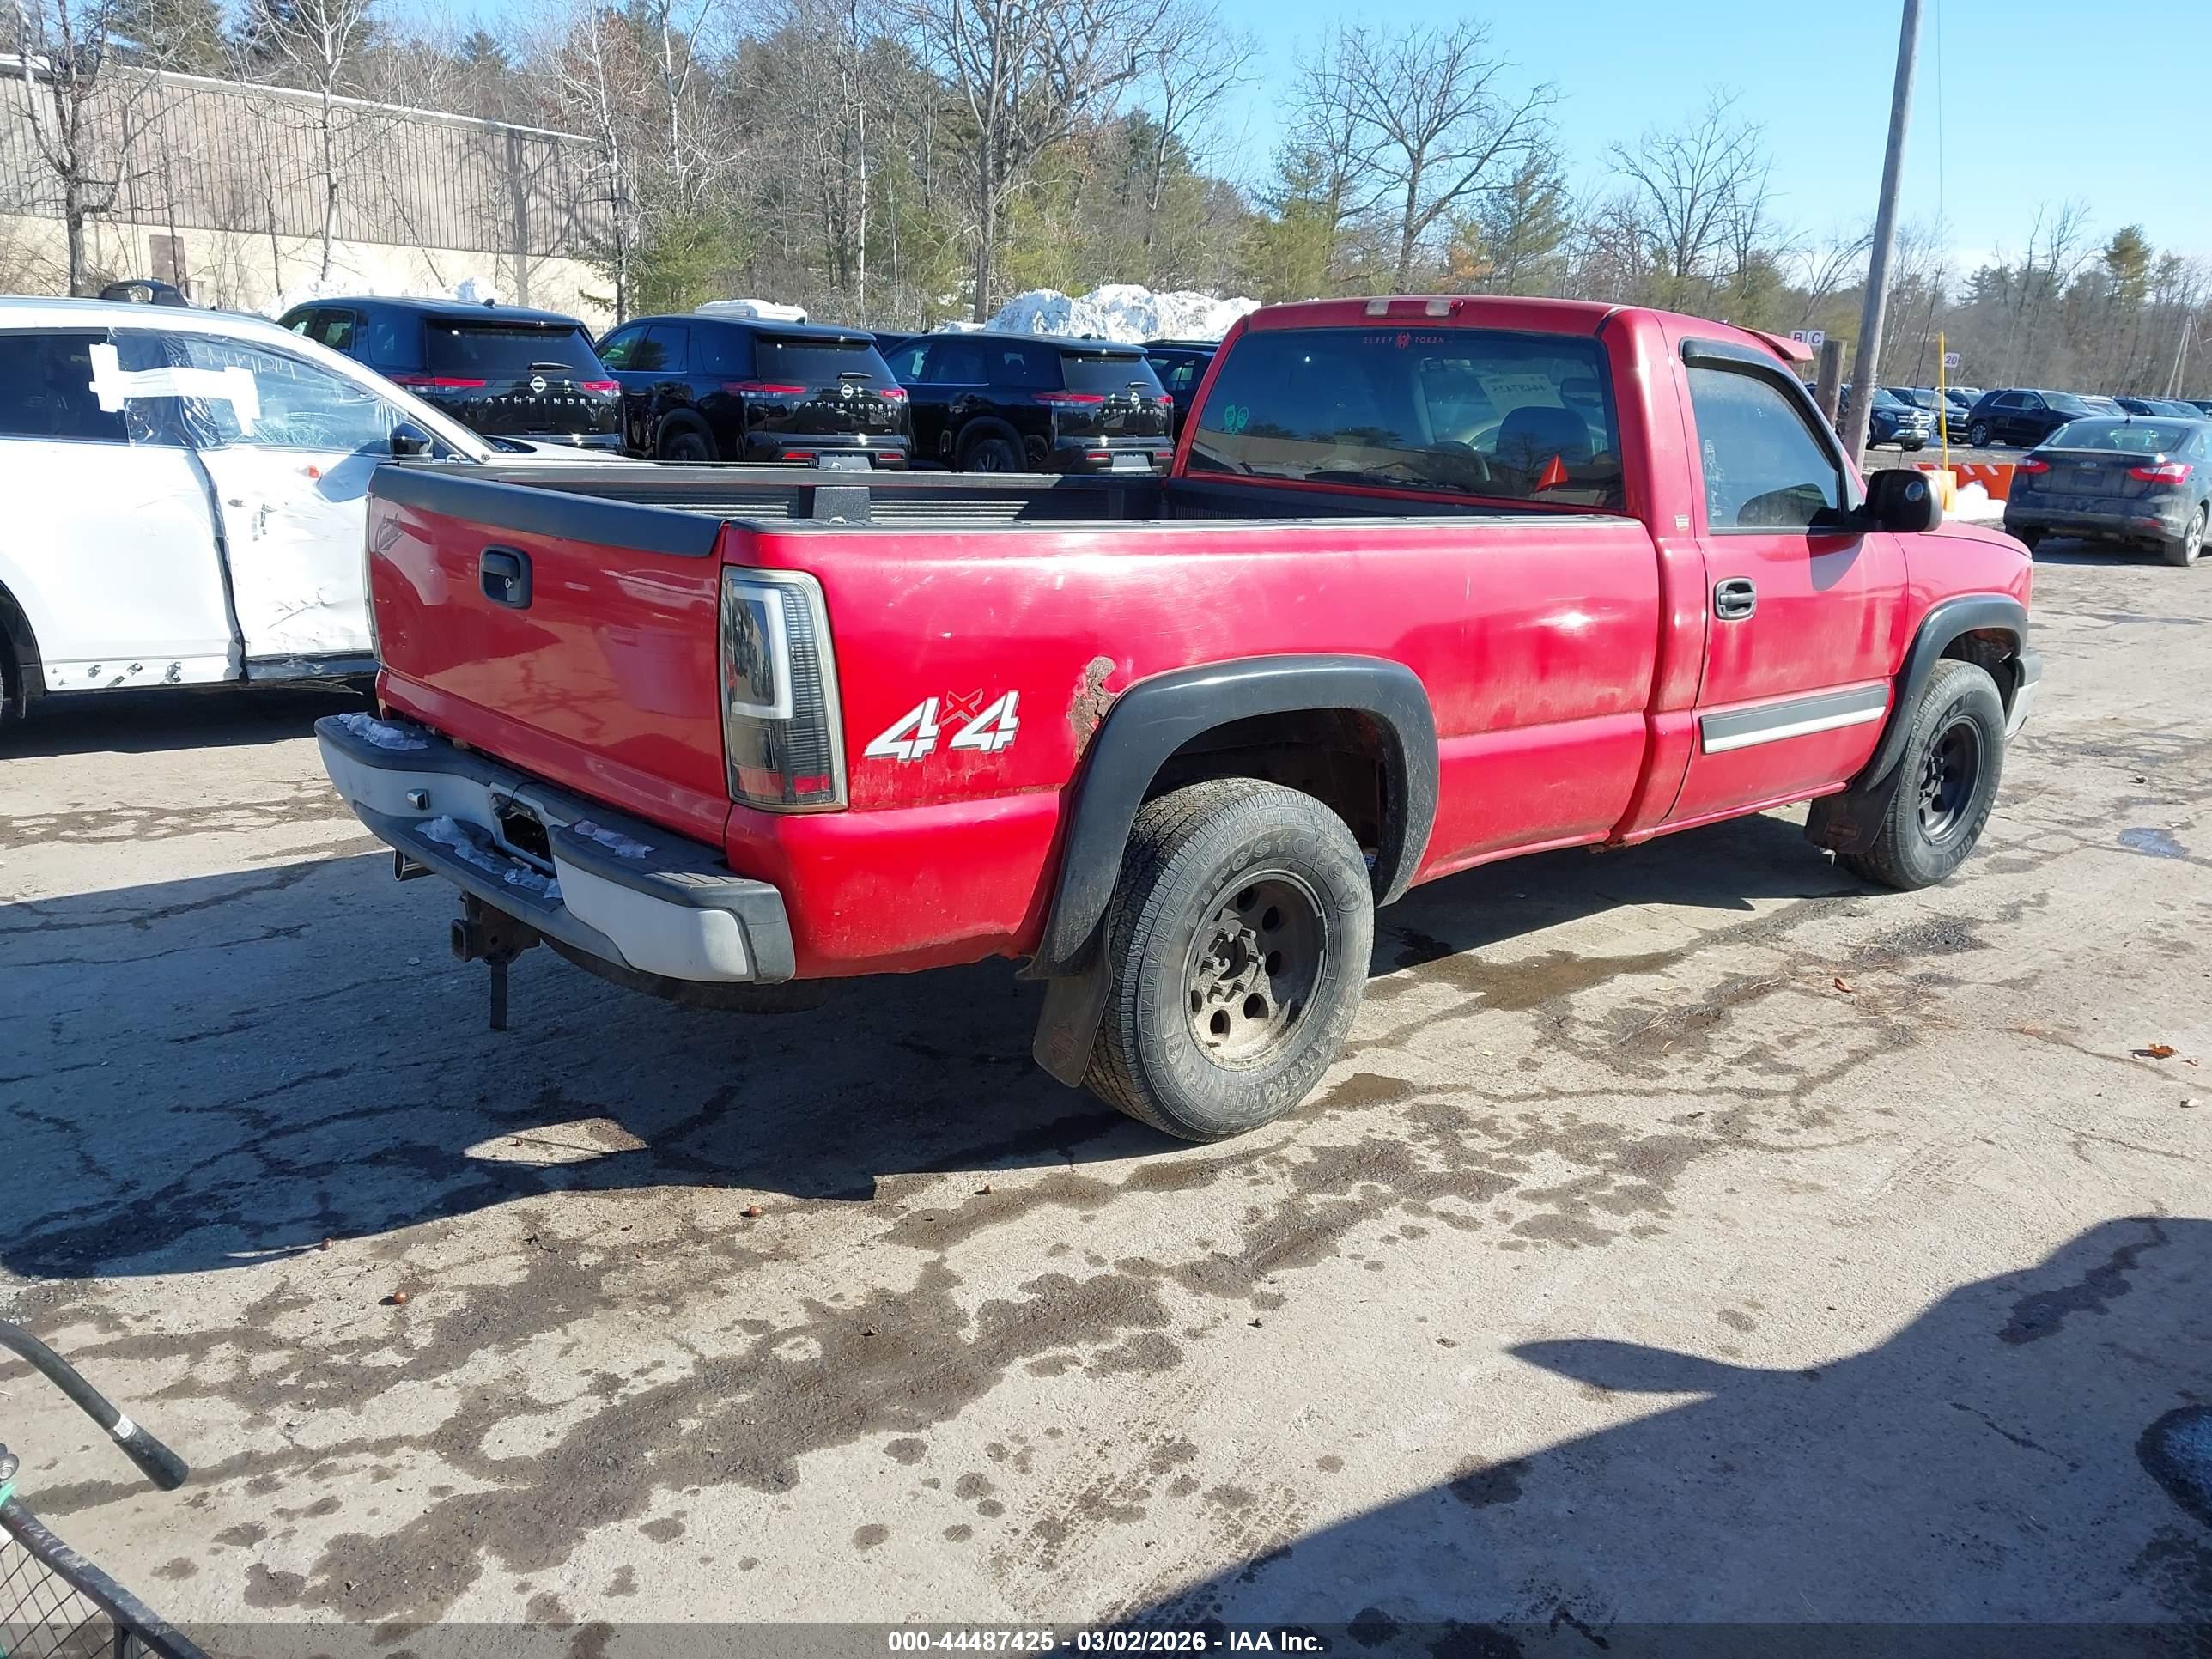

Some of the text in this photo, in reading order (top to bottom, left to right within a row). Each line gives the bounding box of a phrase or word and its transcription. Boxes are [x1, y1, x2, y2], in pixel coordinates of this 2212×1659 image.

[1793, 332, 1803, 343] B
[1811, 332, 1821, 344] C
[1945, 355, 1958, 366] 20
[470, 396, 599, 405] PATHFINDER
[793, 400, 893, 410] PATHFINDER
